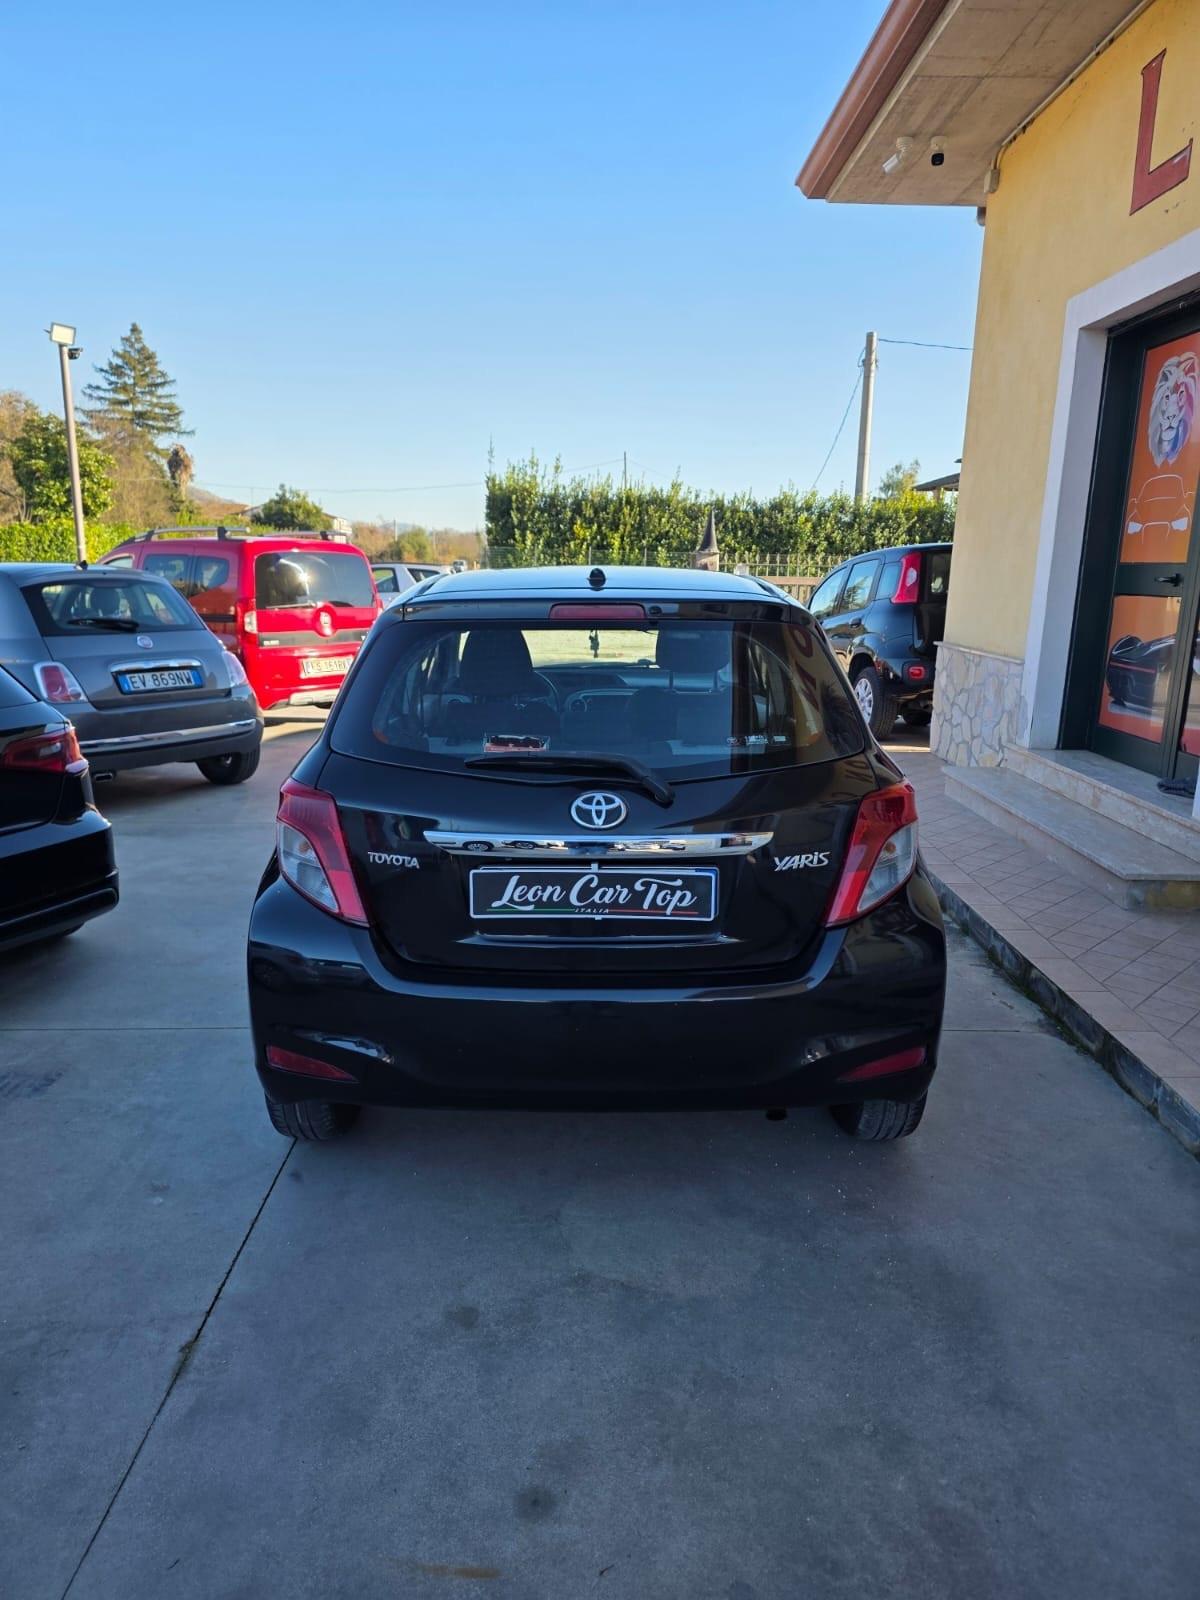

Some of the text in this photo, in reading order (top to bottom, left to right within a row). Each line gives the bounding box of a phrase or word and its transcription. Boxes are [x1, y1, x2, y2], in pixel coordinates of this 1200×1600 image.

[1129, 47, 1194, 216] L
[128, 671, 193, 689] EV 869NW
[367, 851, 420, 869] TOYOTA
[491, 873, 698, 915] Leon Car Top
